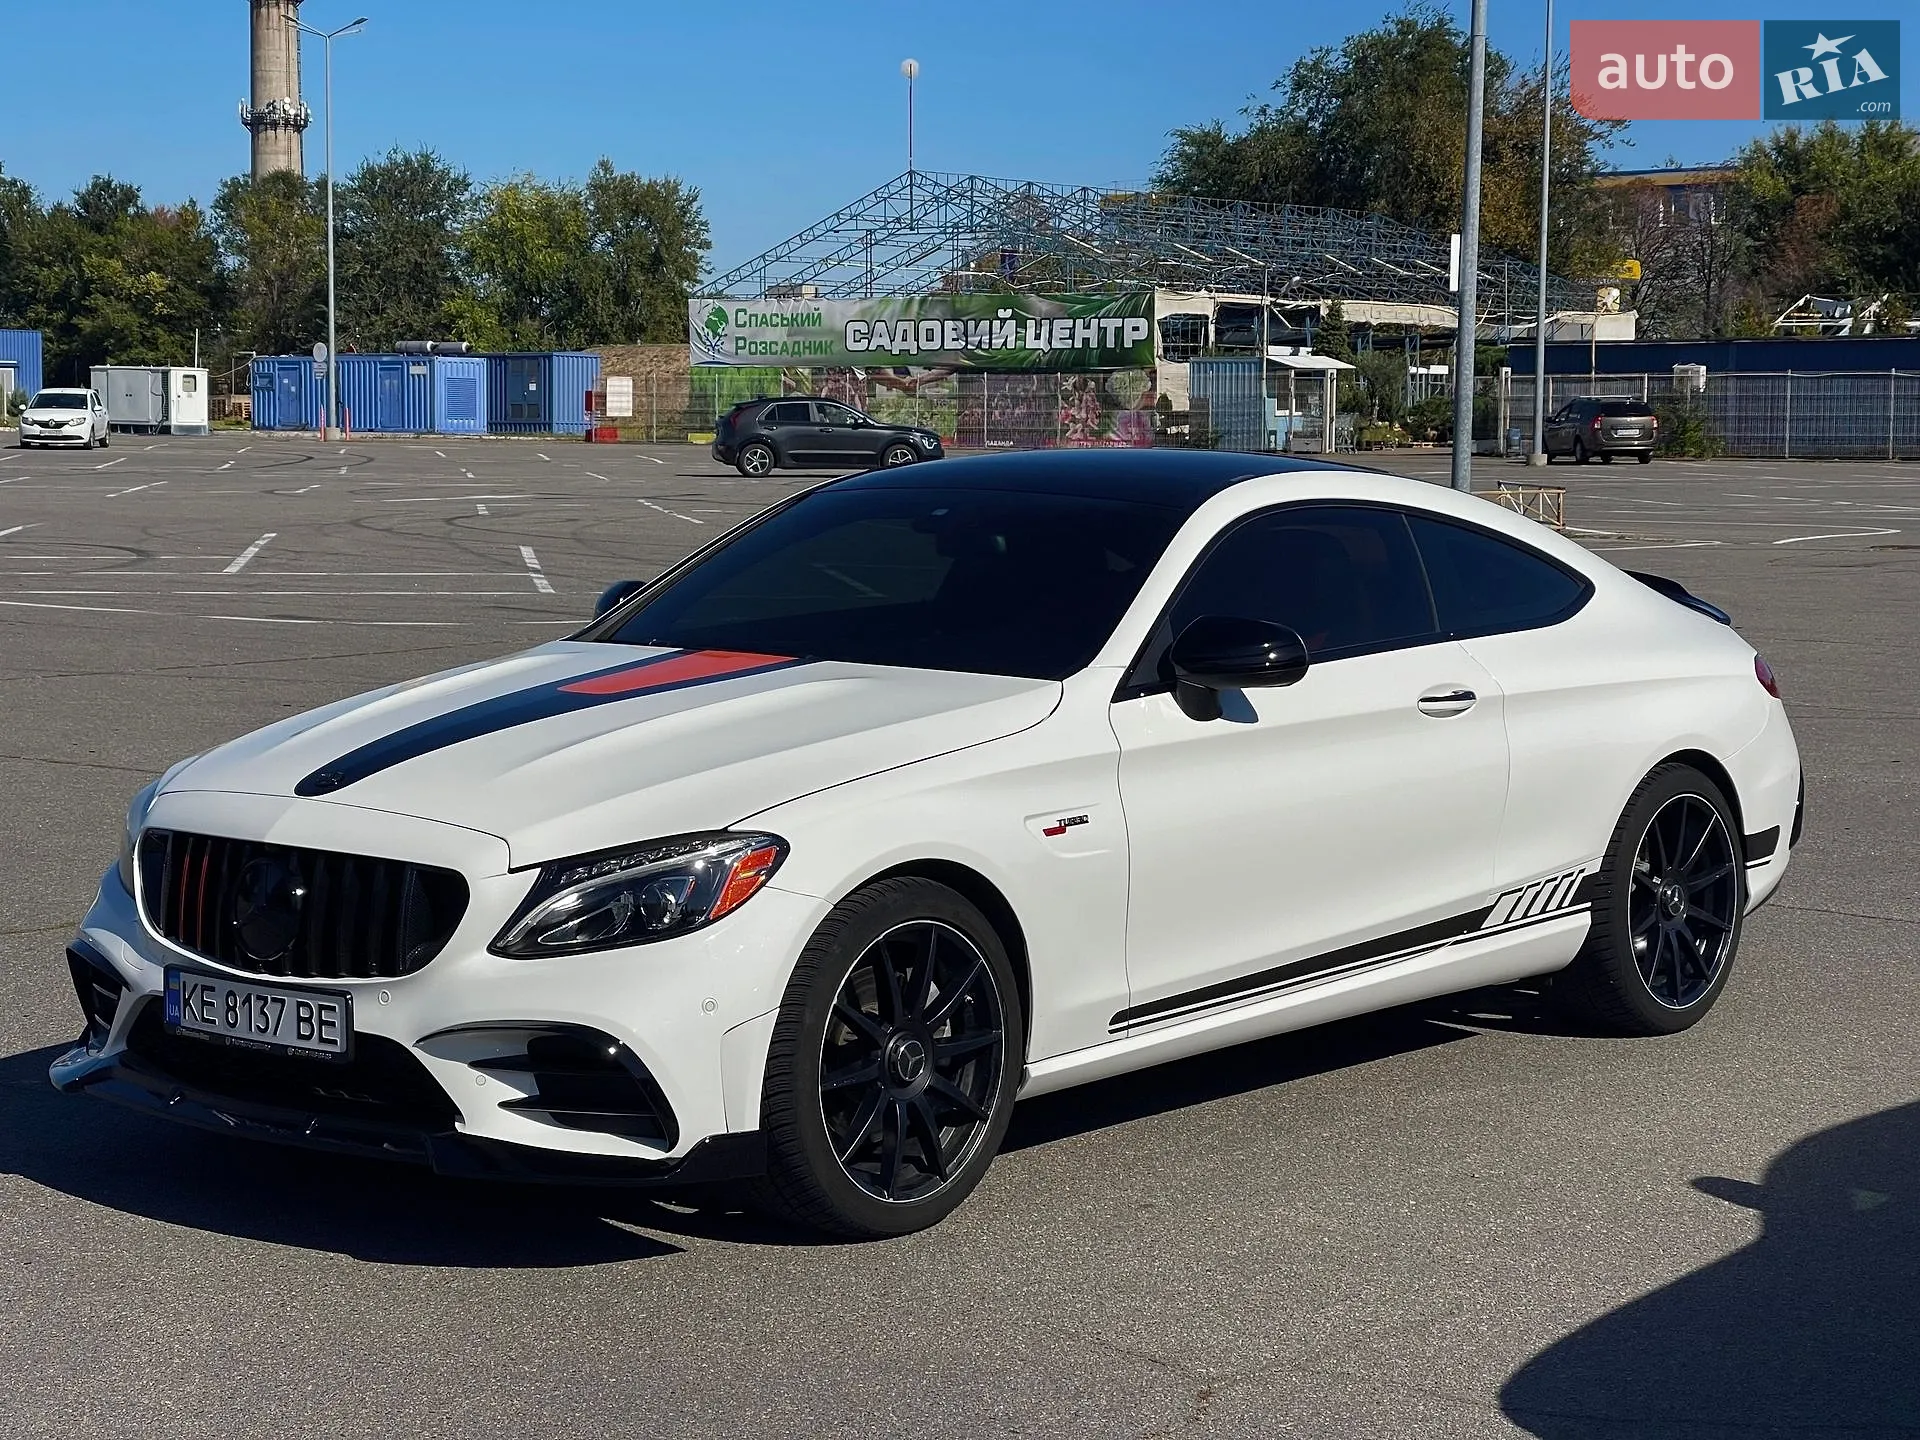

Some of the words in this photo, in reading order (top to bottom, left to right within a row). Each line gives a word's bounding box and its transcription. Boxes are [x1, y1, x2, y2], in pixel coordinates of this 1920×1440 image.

[845, 308, 1017, 355] САДОВИЙ
[1024, 317, 1149, 353] ЦЕНТР
[169, 1003, 180, 1018] UA
[182, 981, 218, 1026] KE
[225, 989, 287, 1037] 8137
[296, 1000, 340, 1046] BE
